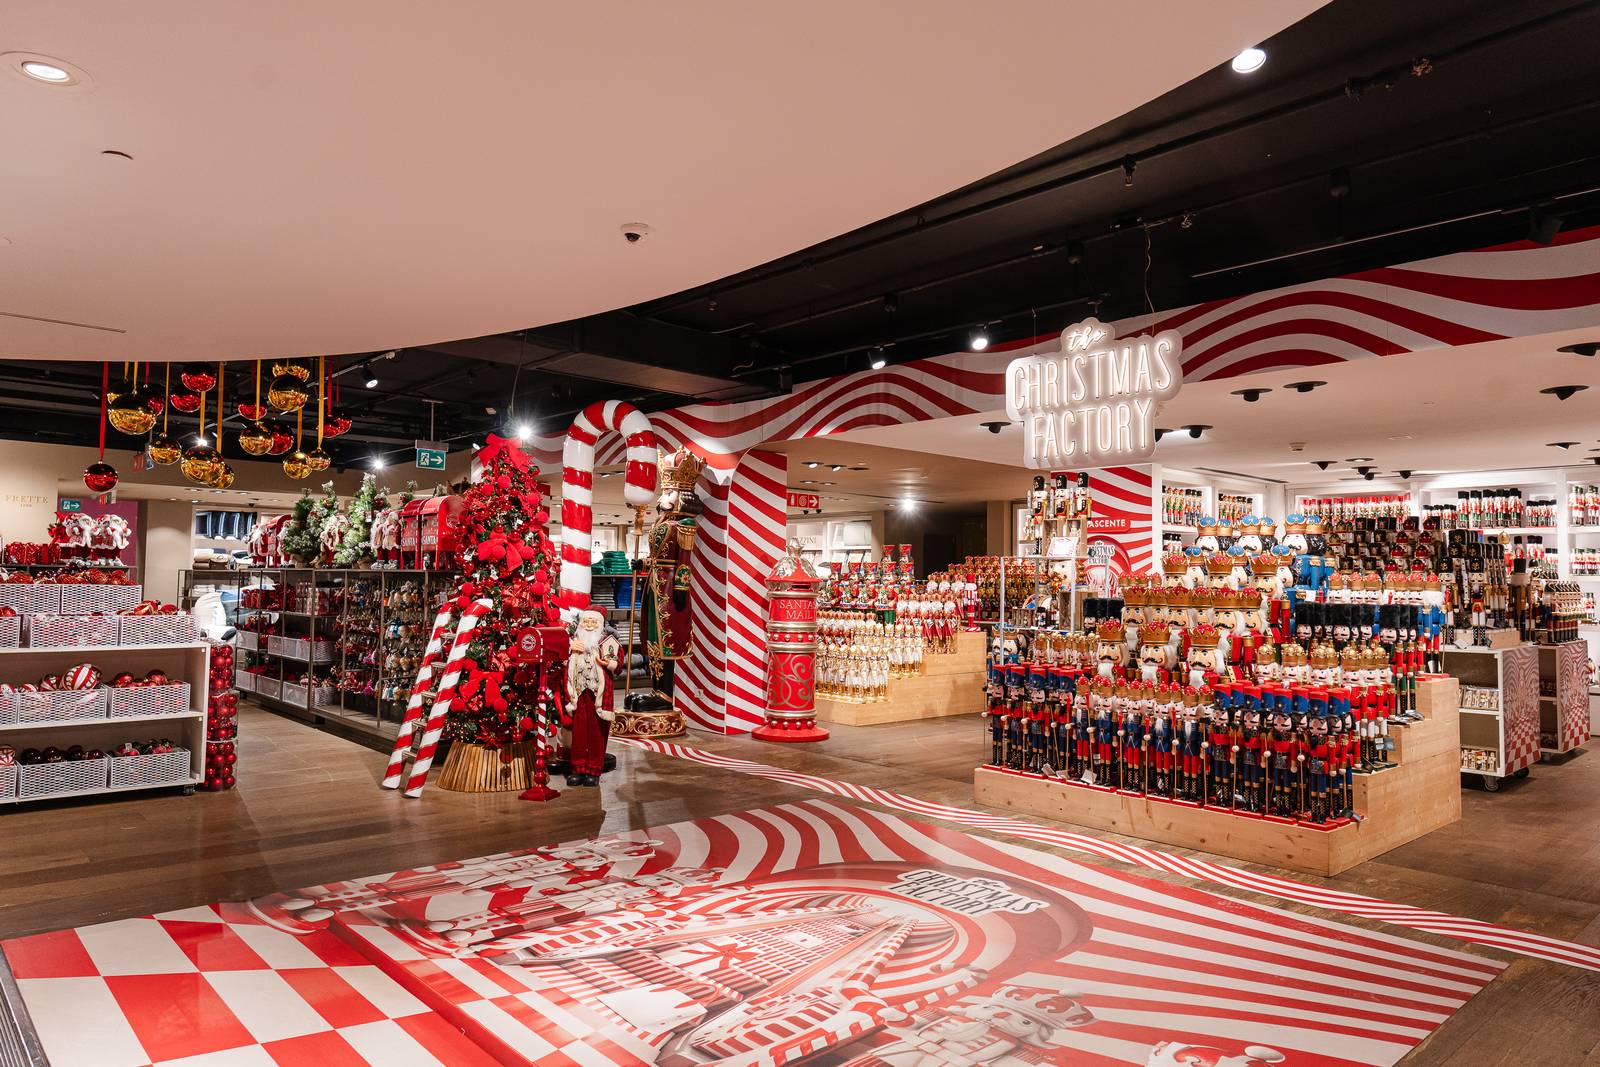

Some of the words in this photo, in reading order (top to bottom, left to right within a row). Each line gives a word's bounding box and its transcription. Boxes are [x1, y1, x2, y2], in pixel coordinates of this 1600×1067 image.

[1067, 326, 1107, 350] the
[1013, 339, 1173, 410] CHRISTMAS
[1032, 398, 1153, 459] FACTORY
[6, 495, 48, 504] FRETTE
[1087, 519, 1126, 528] ASCENTE
[786, 610, 813, 620] MAIL
[889, 881, 996, 915] FACTORY
[904, 870, 1042, 912] CHRISTMAS
